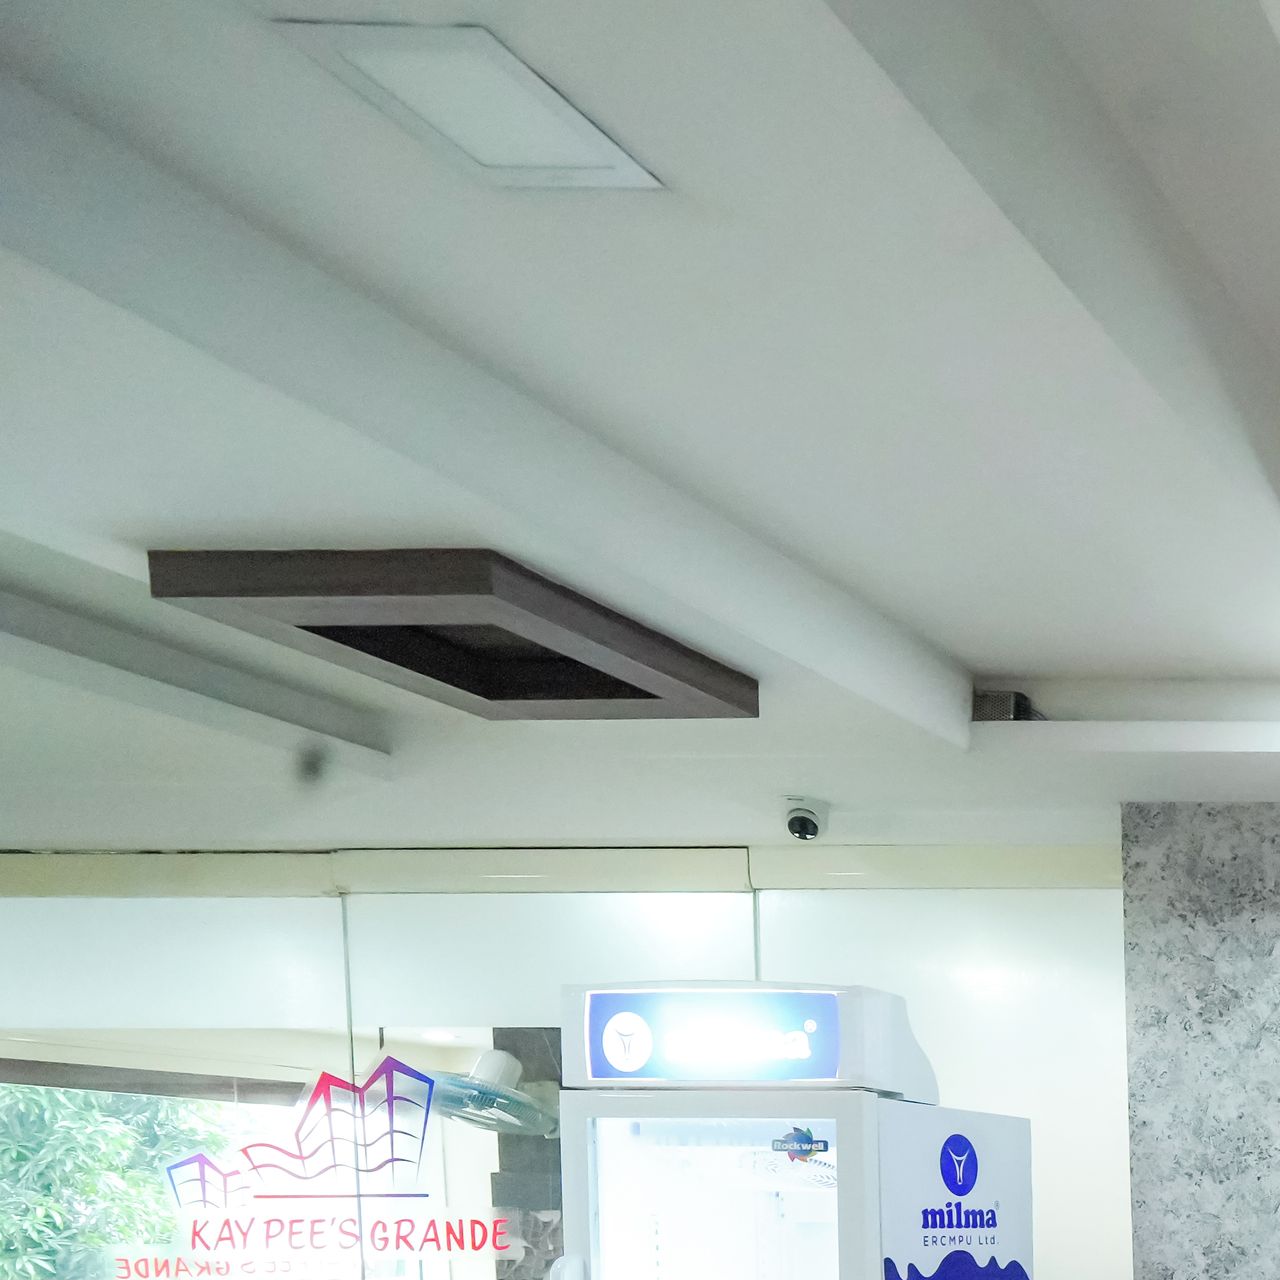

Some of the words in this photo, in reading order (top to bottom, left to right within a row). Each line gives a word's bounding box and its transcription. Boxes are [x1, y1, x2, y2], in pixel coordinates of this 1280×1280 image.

[773, 1141, 824, 1151] Rockwell
[921, 1201, 998, 1229] milma
[191, 1218, 255, 1251] KAY
[263, 1218, 360, 1251] PEE'S
[370, 1218, 512, 1252] GRANDE
[923, 1235, 972, 1247] ERCMPU
[978, 1235, 1000, 1245] Ltd.
